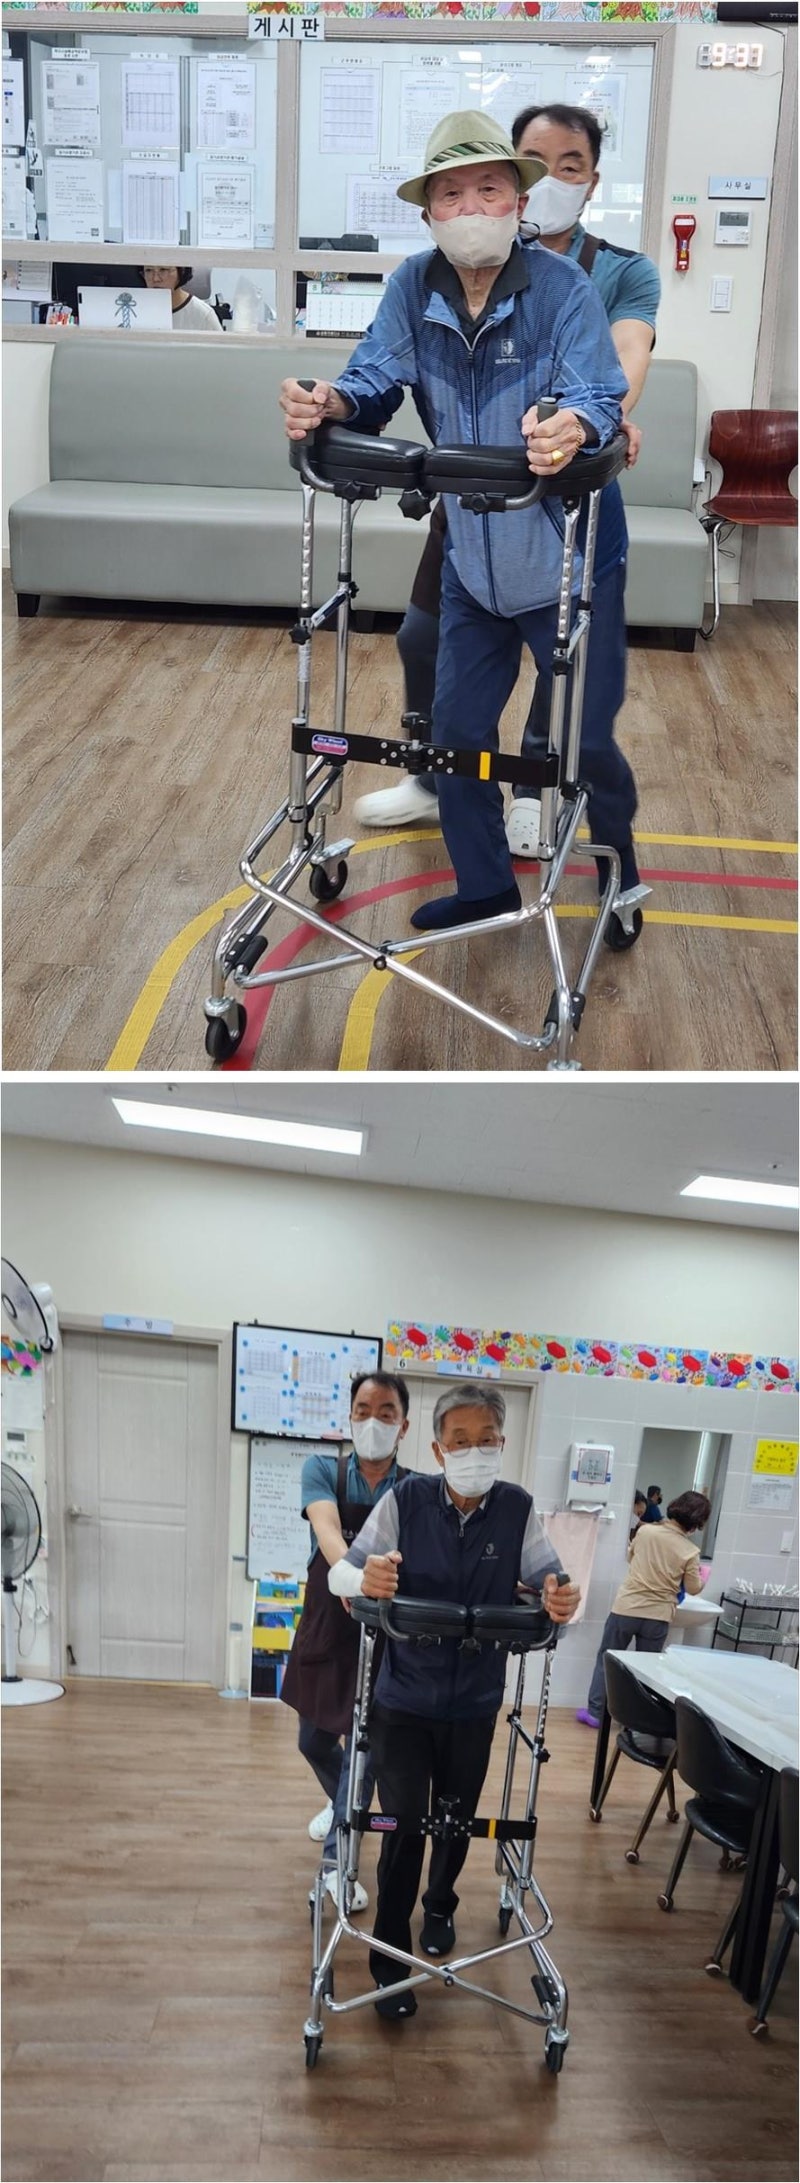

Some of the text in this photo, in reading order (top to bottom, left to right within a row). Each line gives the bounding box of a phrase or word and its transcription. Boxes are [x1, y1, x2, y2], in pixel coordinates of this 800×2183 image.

[254, 17, 319, 38] 게시판
[725, 181, 752, 190] 사무실
[399, 1359, 406, 1368] 6
